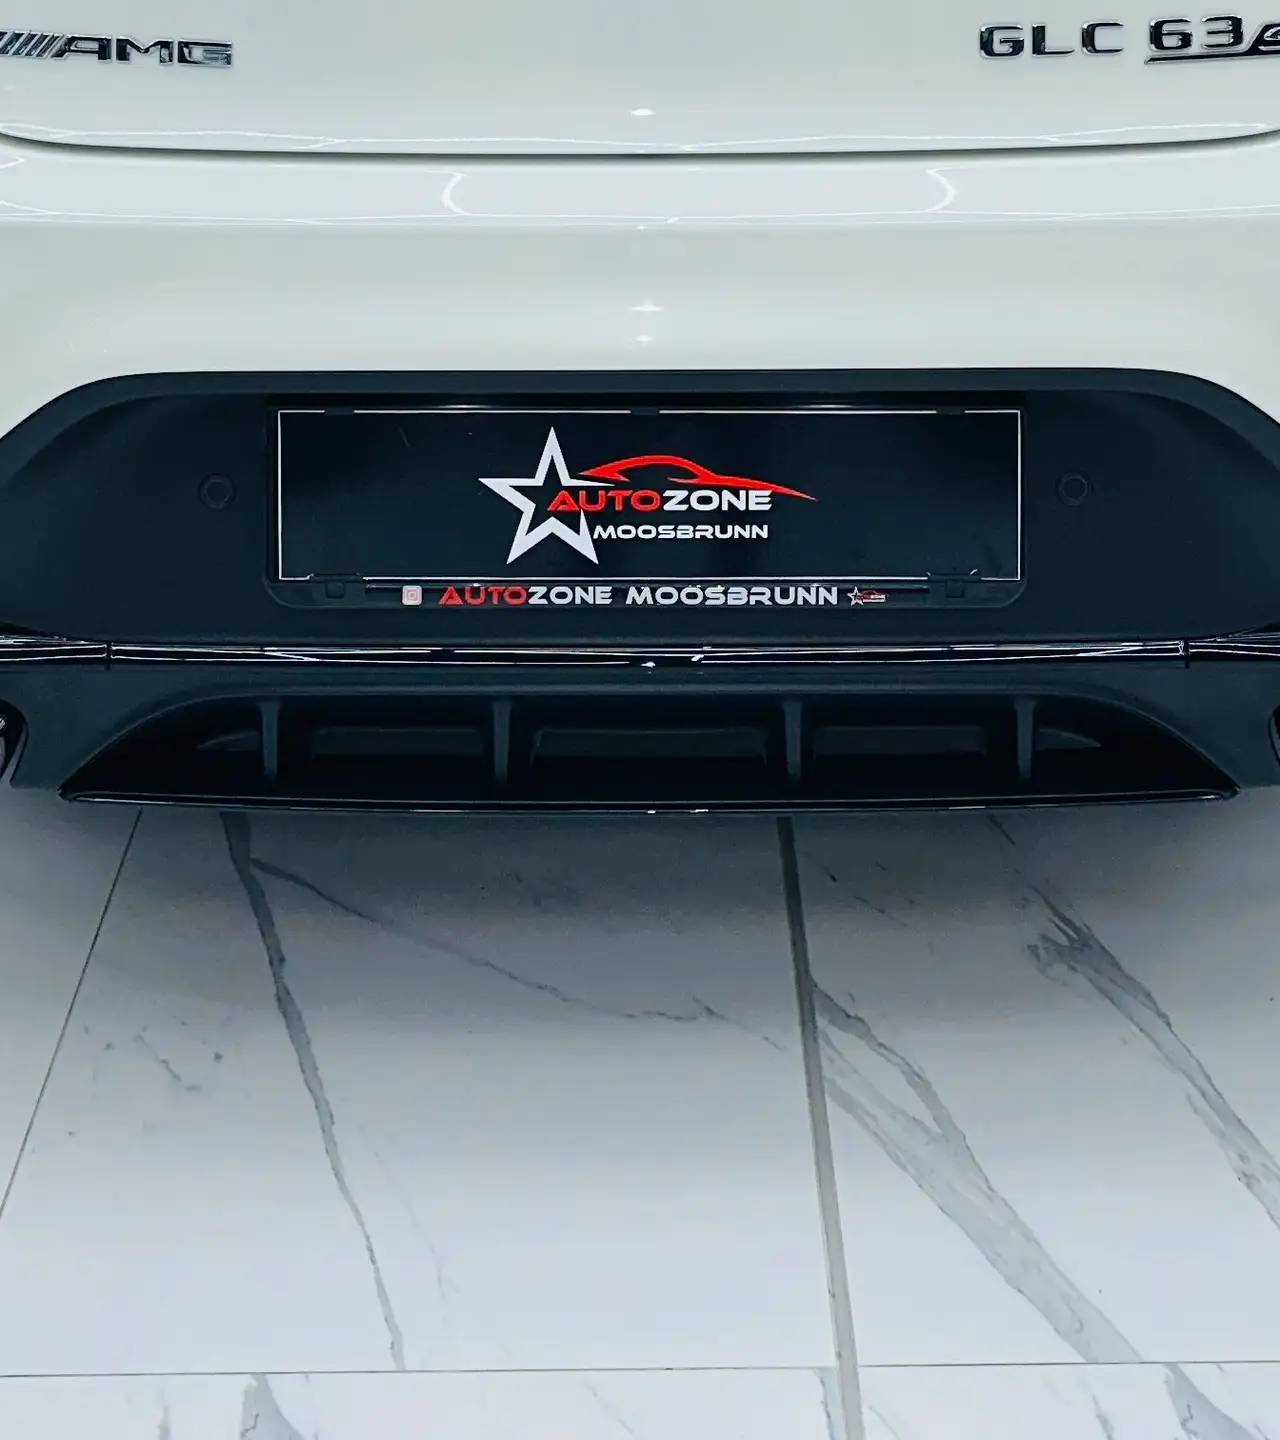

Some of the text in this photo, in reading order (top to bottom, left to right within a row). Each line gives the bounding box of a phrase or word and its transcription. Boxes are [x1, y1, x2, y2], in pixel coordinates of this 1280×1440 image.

[48, 34, 233, 67] AMG
[979, 21, 1124, 60] GLC
[547, 489, 773, 512] AUTOZONE
[592, 524, 769, 540] MOOSBRUNN
[438, 586, 614, 606] AUTOZONE
[625, 585, 838, 606] MOOSBRUNN
